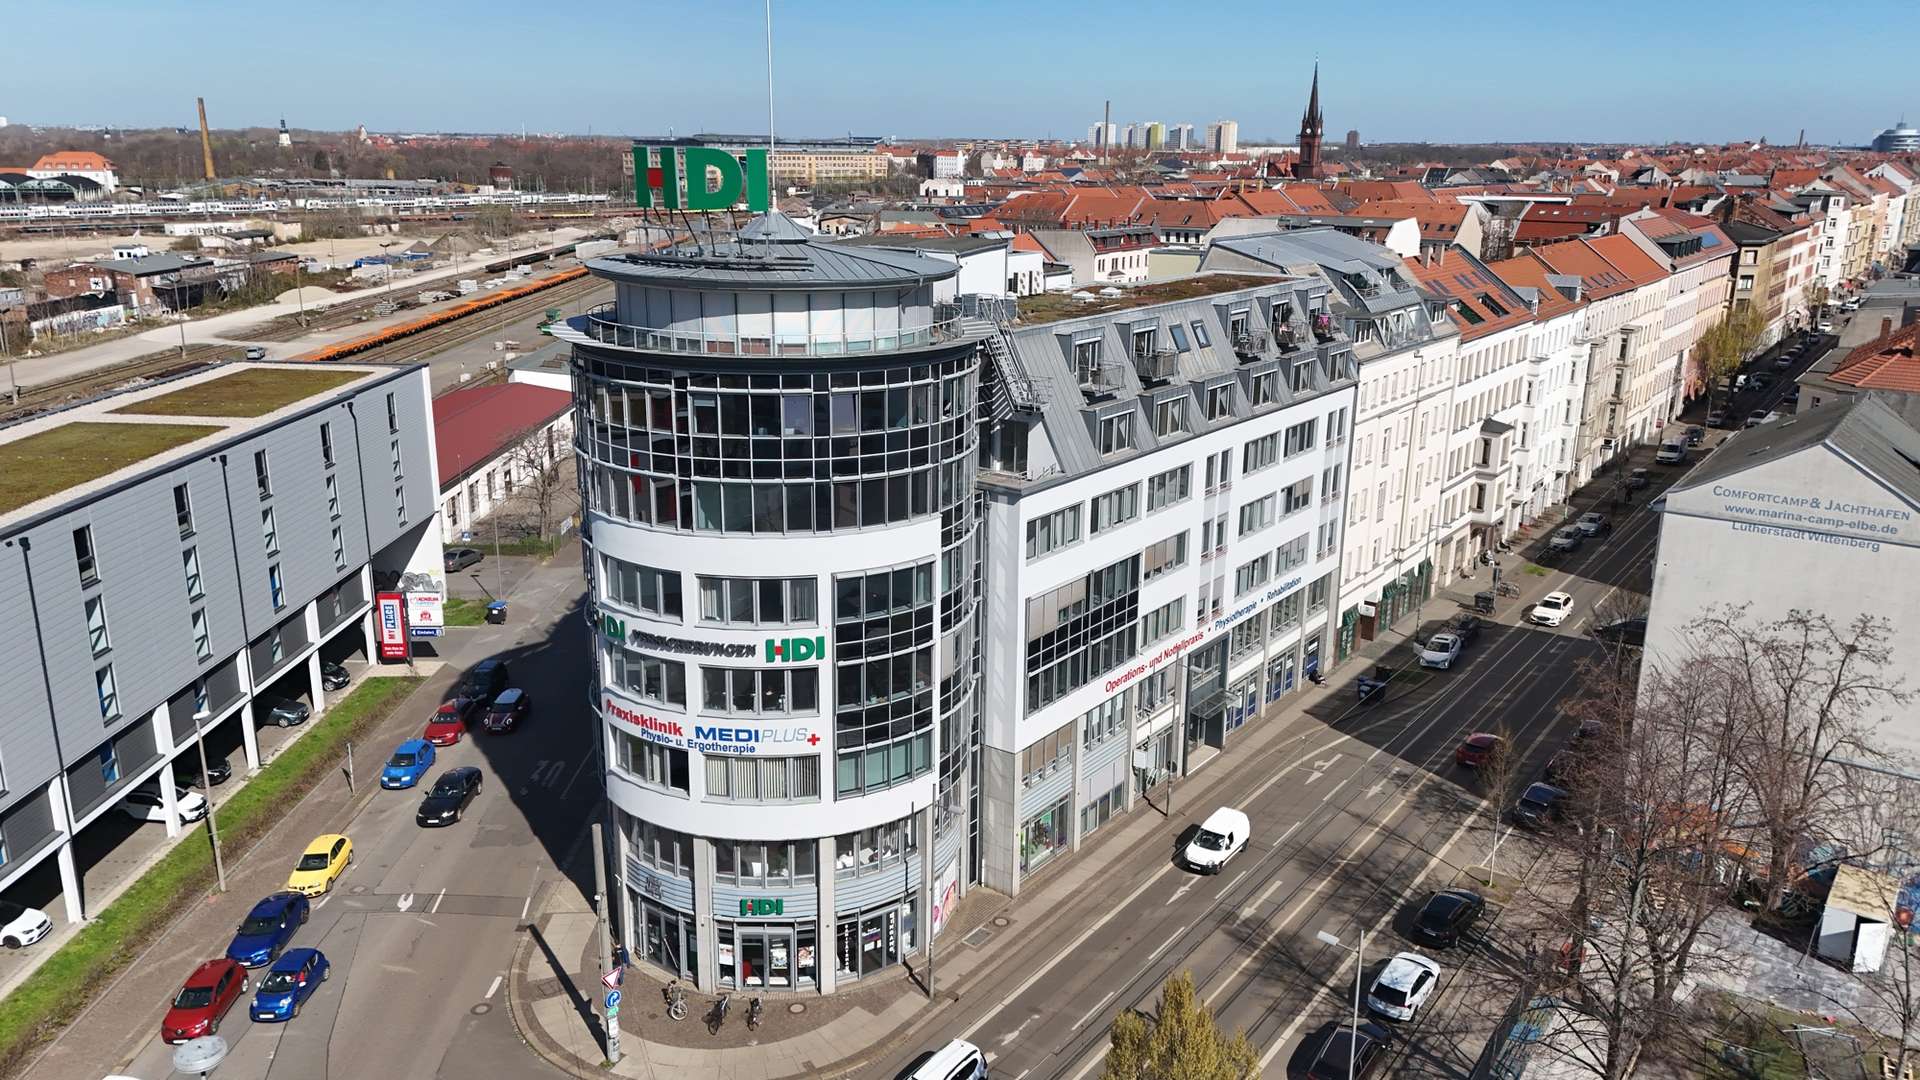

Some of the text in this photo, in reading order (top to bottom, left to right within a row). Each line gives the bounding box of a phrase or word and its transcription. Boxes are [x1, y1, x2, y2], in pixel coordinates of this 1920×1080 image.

[633, 145, 769, 212] HDI
[1724, 503, 1898, 535] www.marina-camp-elbe.de
[1809, 497, 1821, 509] &
[1732, 521, 1881, 553] Lutherstadt Wittenberg
[765, 636, 826, 663] HDI
[1105, 664, 1148, 693] Operations-
[1149, 651, 1163, 669] und
[606, 698, 684, 737] Praxisklinik
[640, 727, 756, 755] Physio- u. Ergotherapie
[739, 896, 784, 916] HDI
